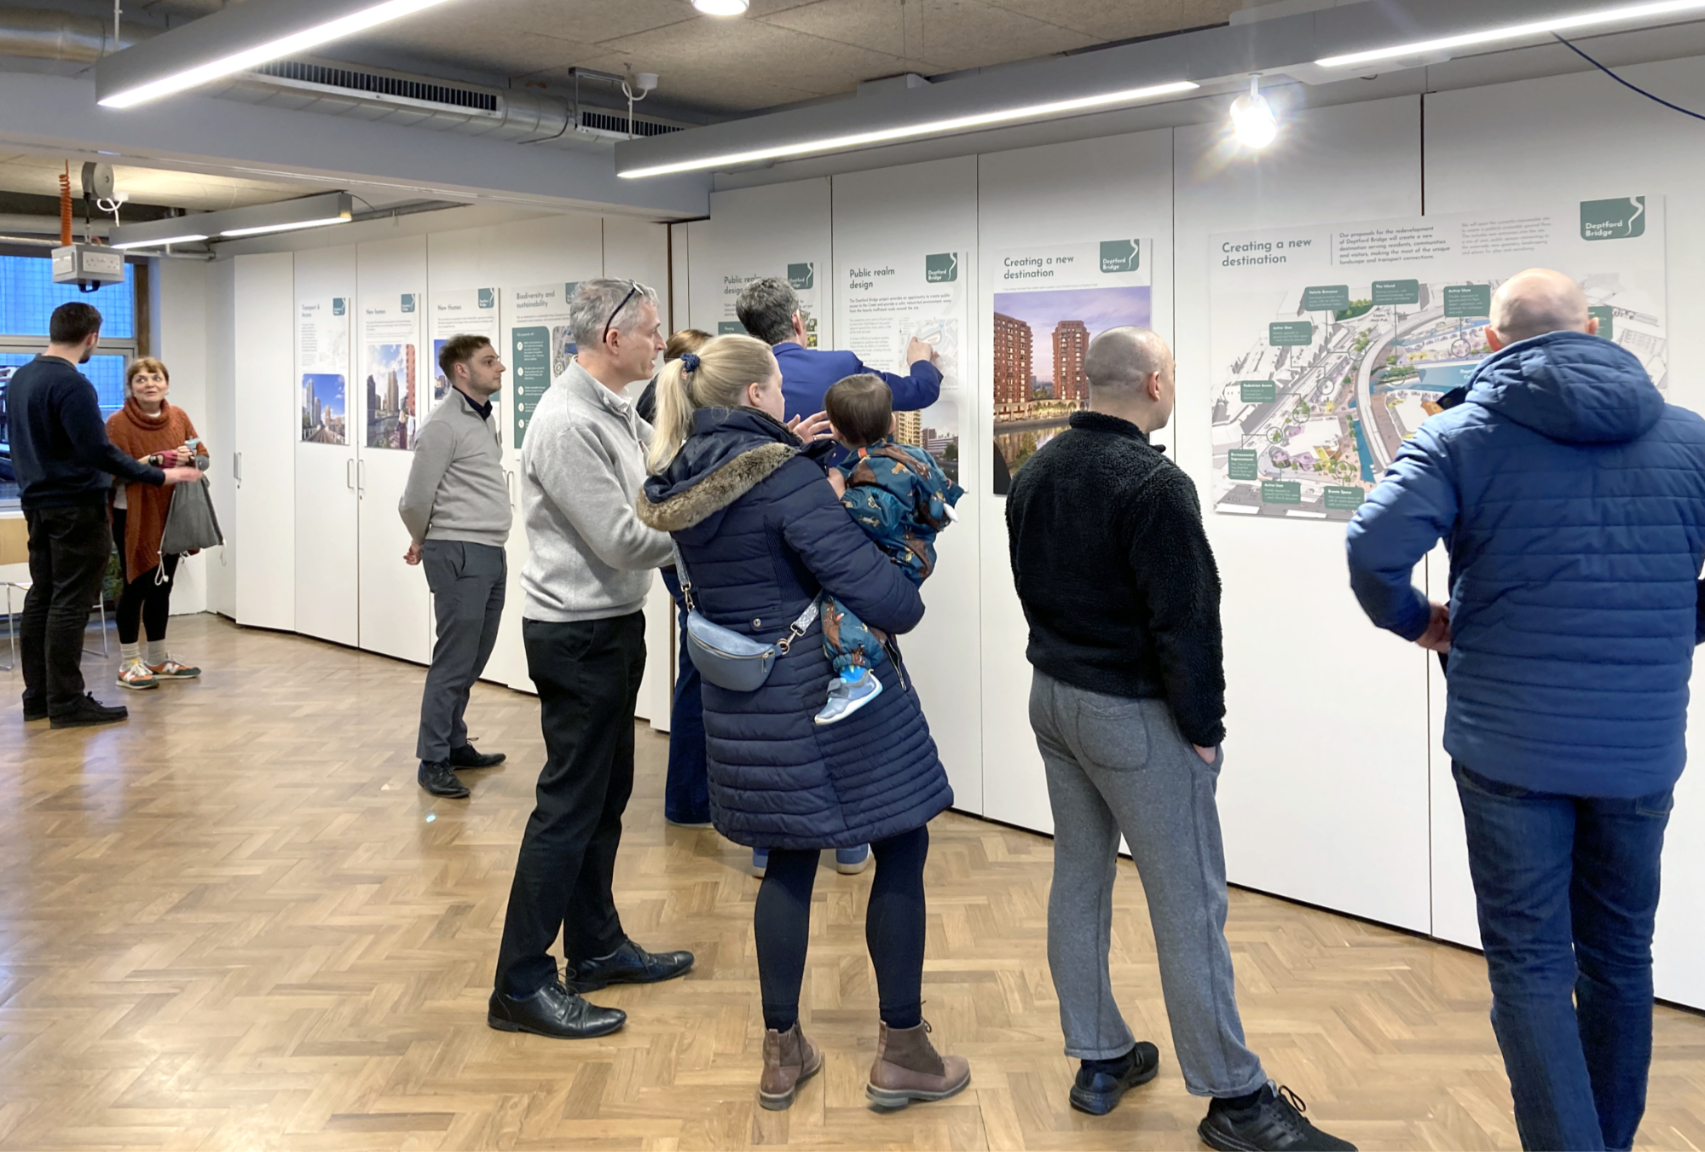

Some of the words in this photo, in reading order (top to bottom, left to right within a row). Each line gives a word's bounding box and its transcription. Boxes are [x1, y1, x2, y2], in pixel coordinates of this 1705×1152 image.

[1586, 220, 1622, 230] Deptford
[1586, 228, 1612, 237] Bridge
[1222, 241, 1272, 252] Creating
[1289, 238, 1312, 247] new
[1004, 257, 1042, 267] Creating
[1056, 256, 1074, 264] new
[1222, 254, 1287, 266] destination
[850, 268, 871, 278] Public
[874, 266, 895, 276] realm
[1004, 269, 1054, 279] destination
[724, 275, 742, 284] Public
[850, 280, 873, 290] design
